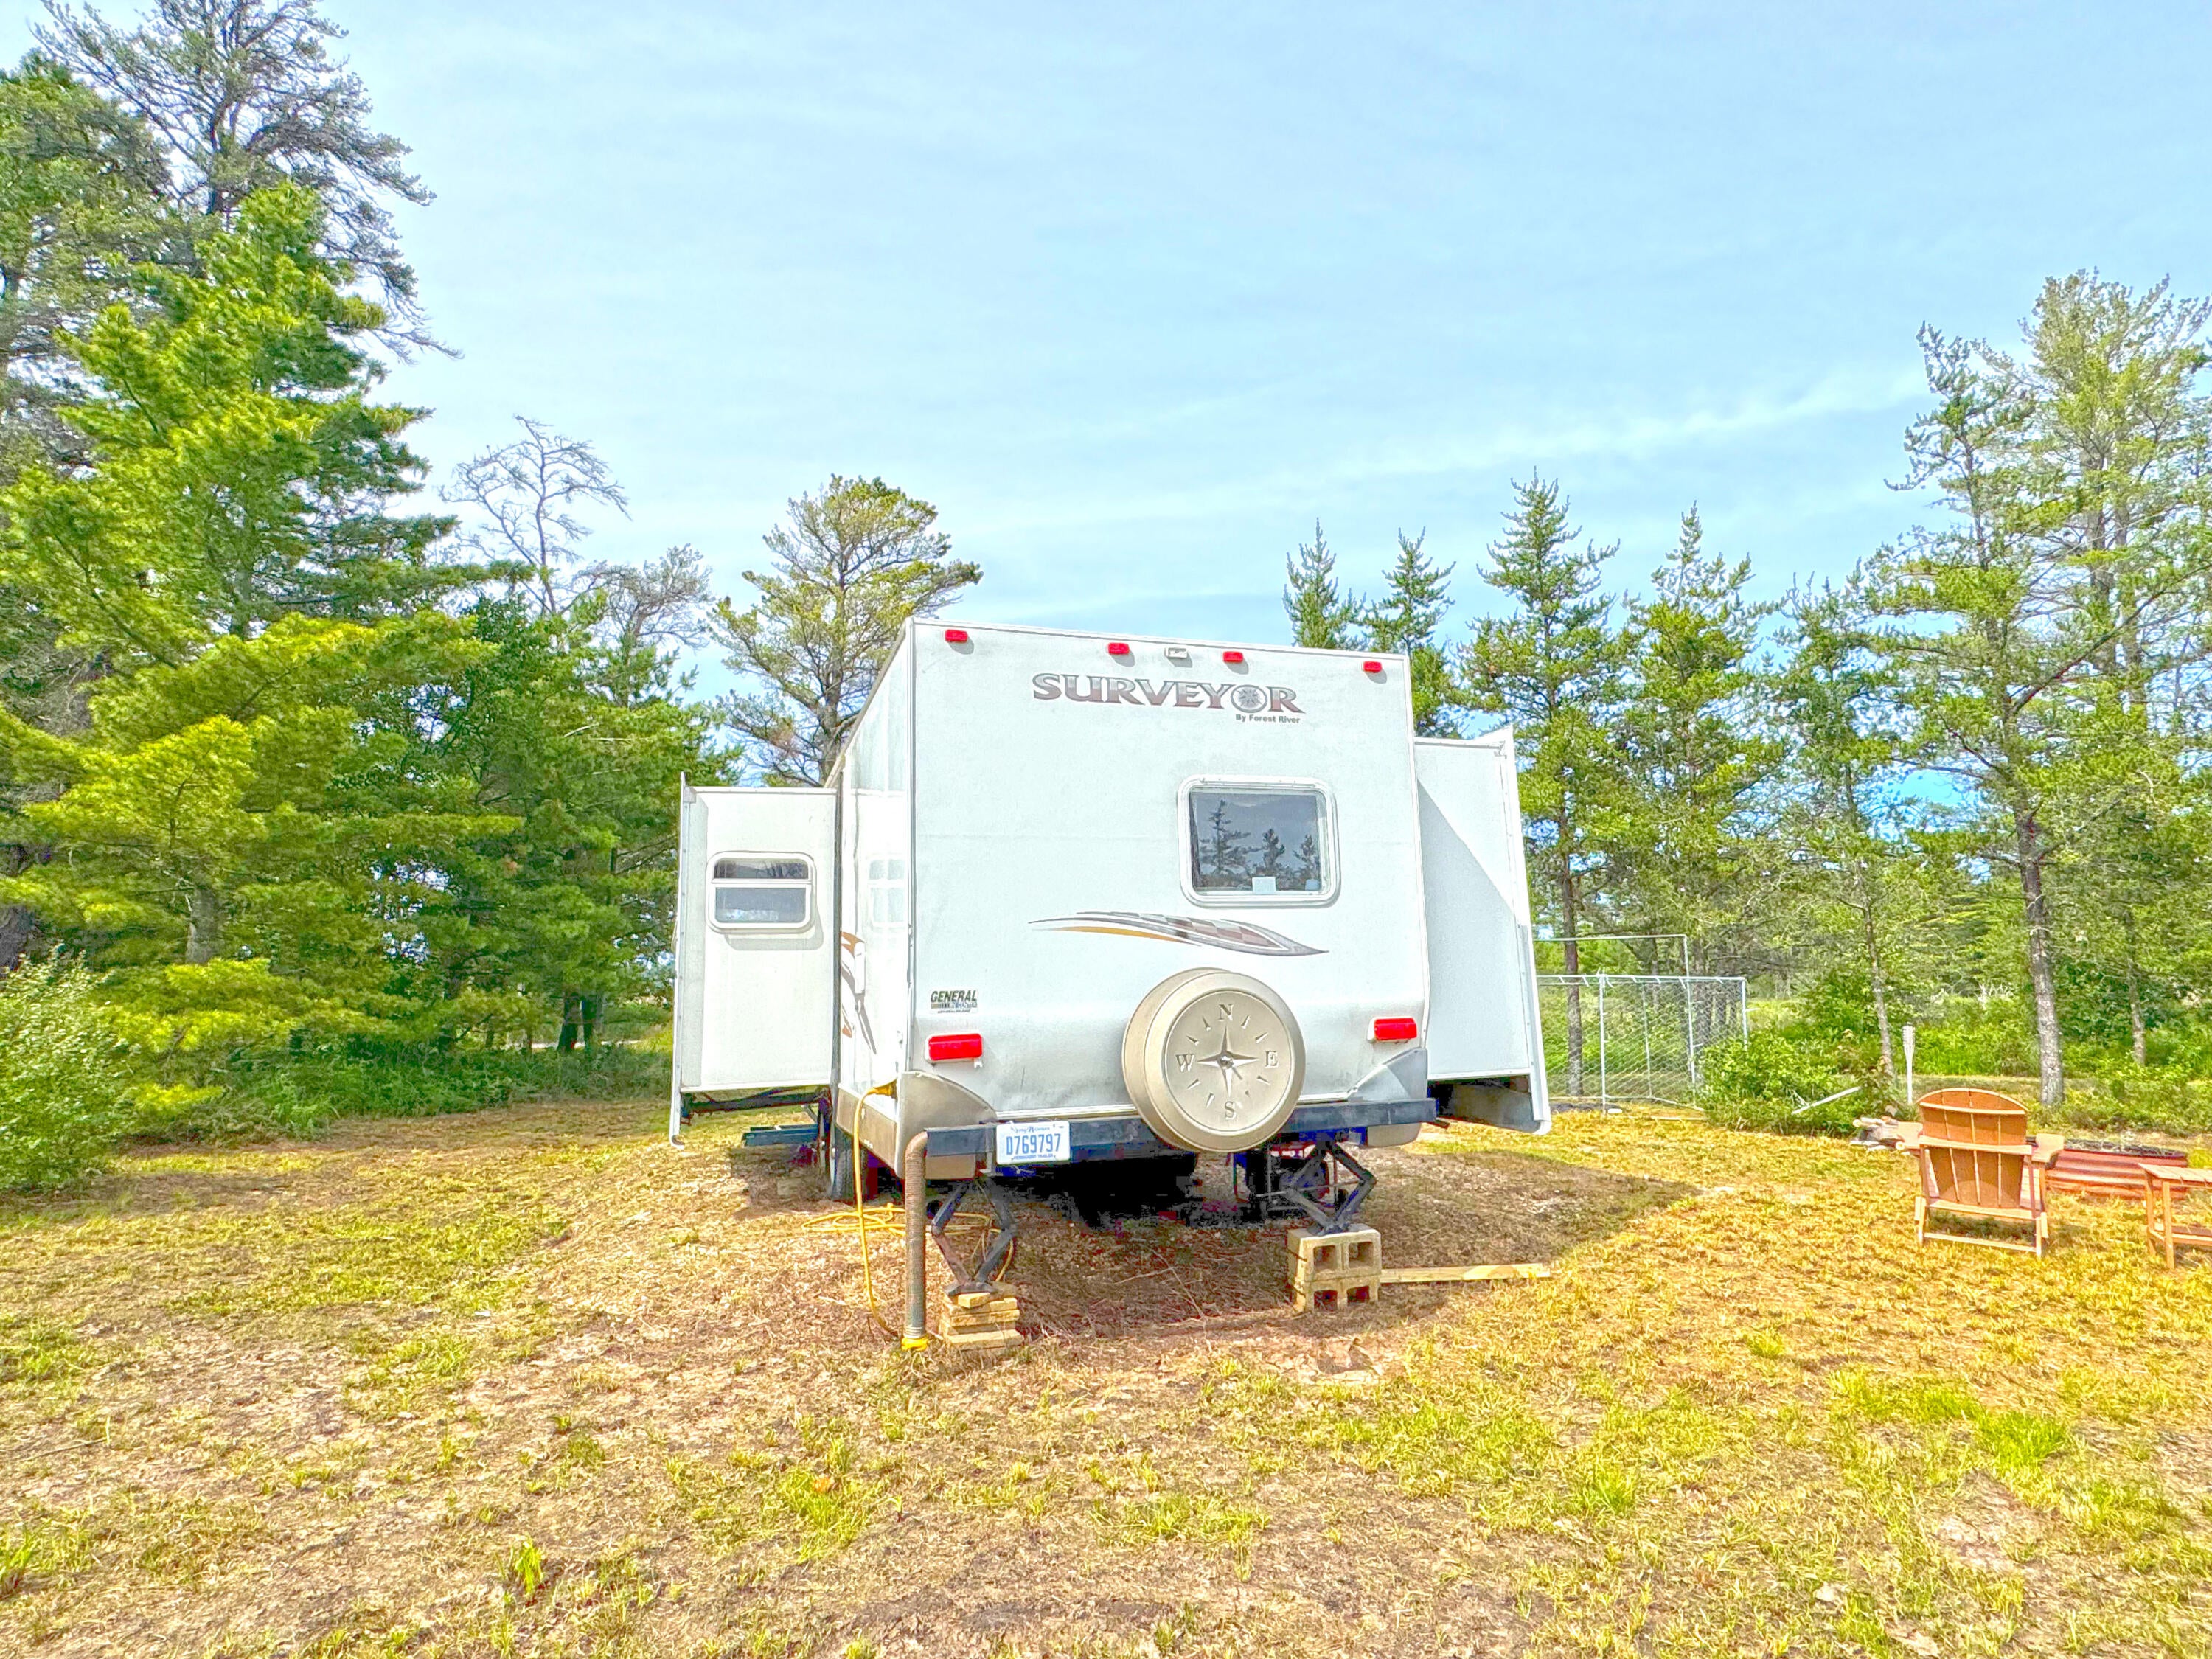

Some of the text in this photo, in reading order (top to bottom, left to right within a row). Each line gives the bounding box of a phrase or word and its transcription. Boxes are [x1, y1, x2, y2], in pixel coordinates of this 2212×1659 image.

[1032, 673, 1305, 714] SURVEYOR
[1235, 713, 1301, 723] By Forest River
[930, 990, 977, 1003] GENERAL
[1217, 1004, 1234, 1021] N
[1175, 1050, 1279, 1072] W E
[1224, 1101, 1237, 1120] S
